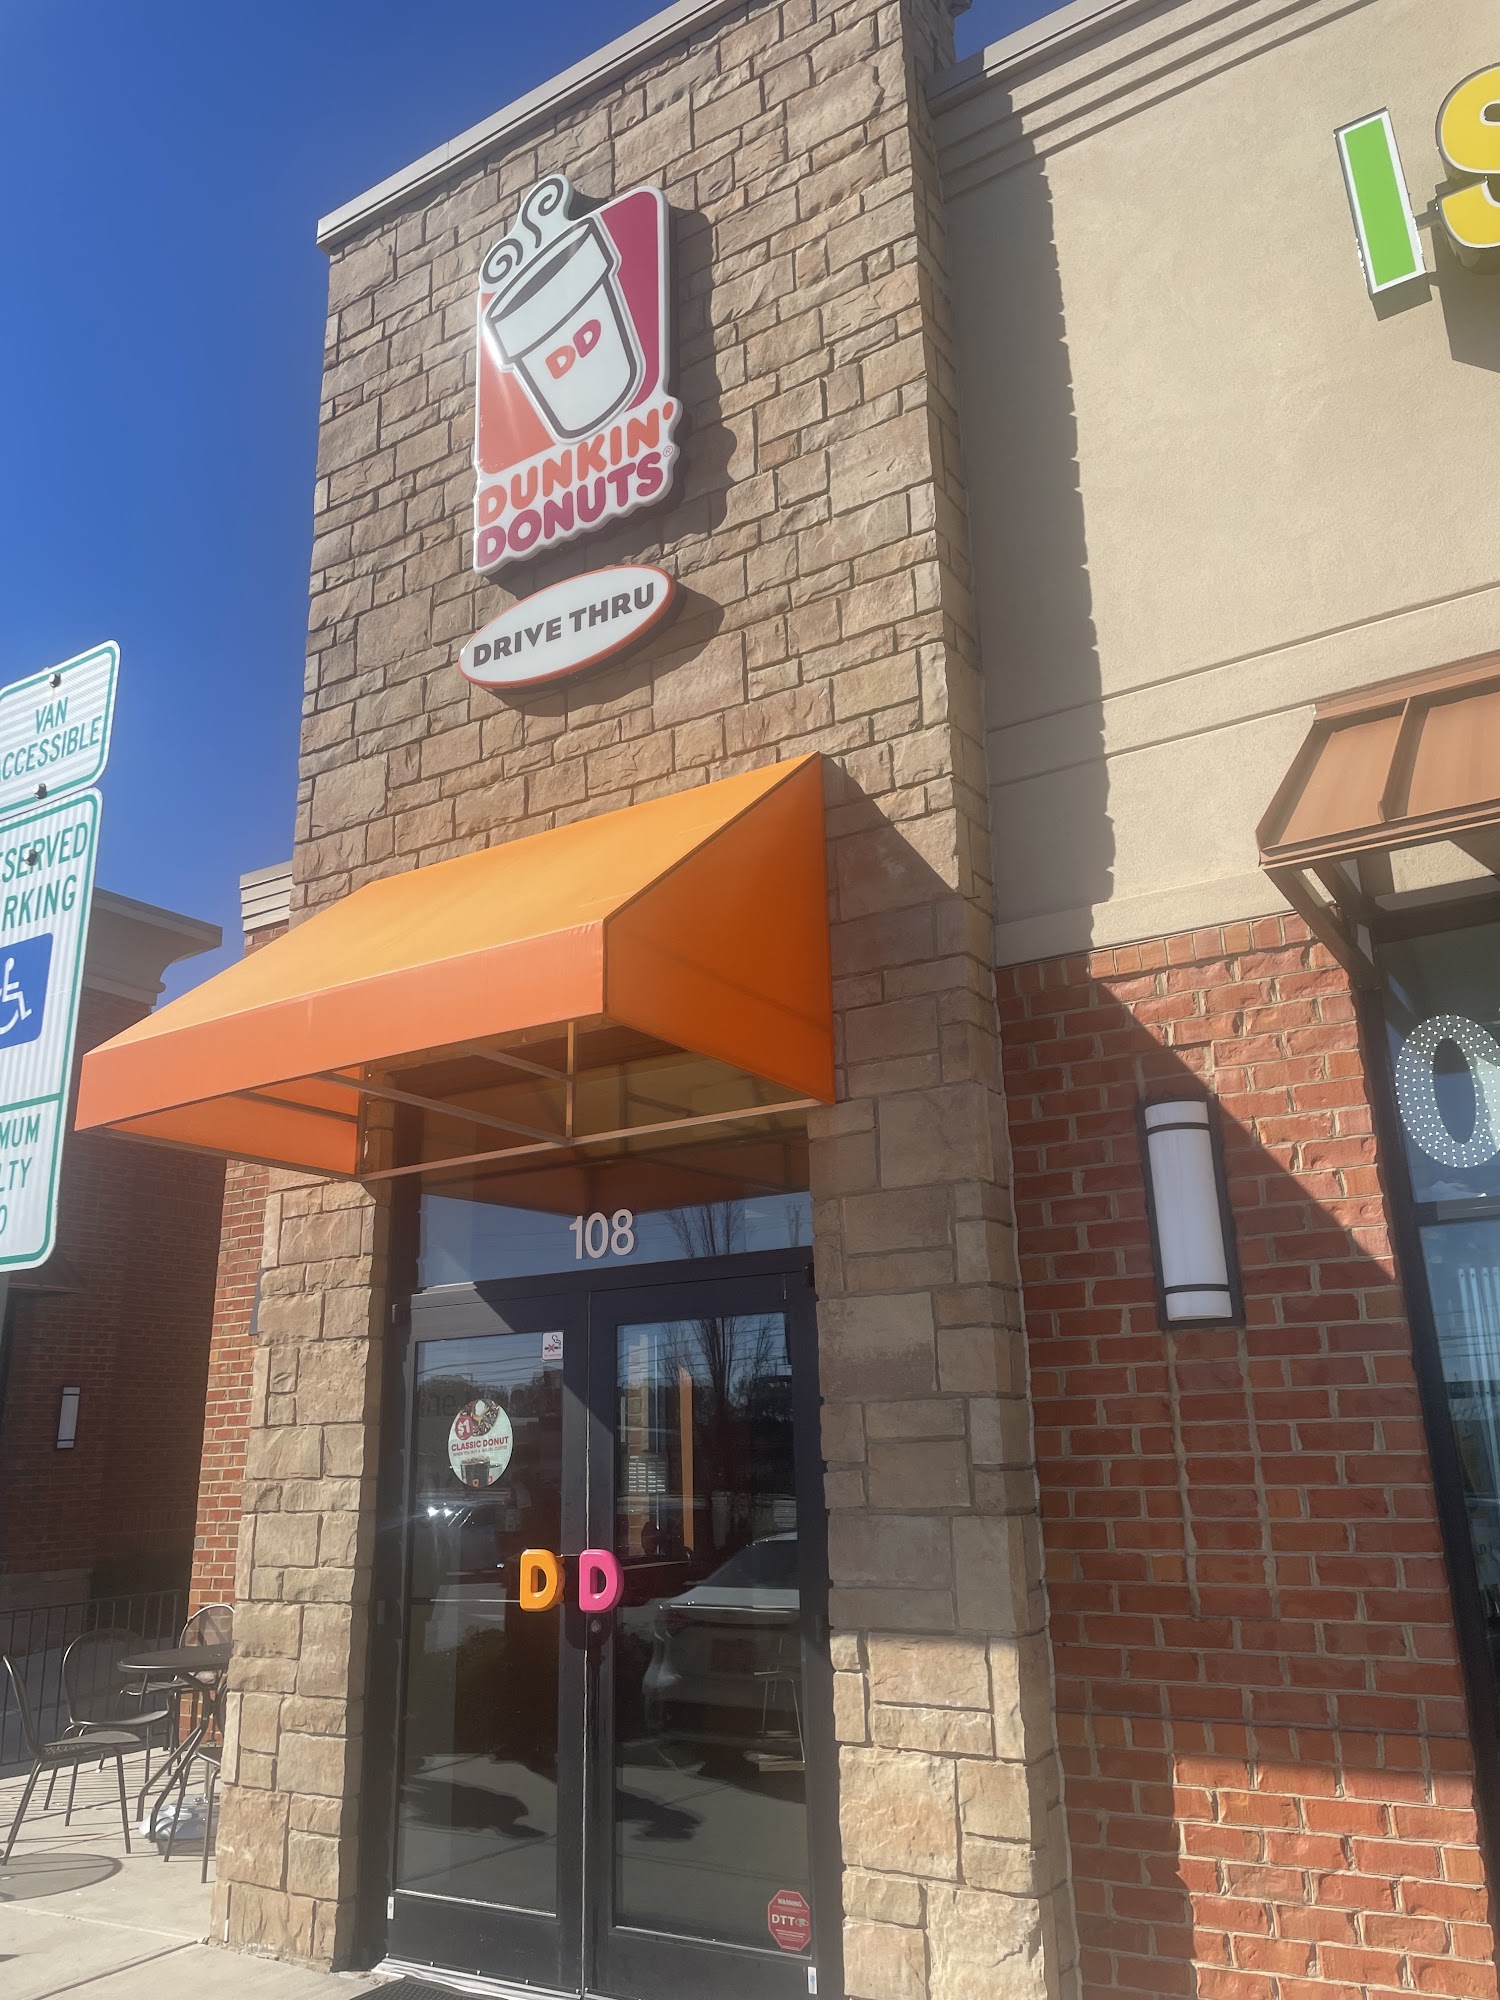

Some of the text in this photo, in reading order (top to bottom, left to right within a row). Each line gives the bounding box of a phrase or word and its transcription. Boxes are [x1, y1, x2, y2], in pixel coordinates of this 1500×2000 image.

[544, 318, 602, 380] DD
[478, 401, 674, 528] DUNKIN'
[477, 451, 664, 568] DONUTS
[473, 582, 655, 668] DRIVE THRU
[35, 696, 69, 735] VAN
[0, 715, 103, 780] CCESSIBLE
[0, 821, 88, 883] SERVED
[569, 1208, 635, 1260] 108
[452, 1436, 509, 1451] CLASSIC DONUT
[458, 1419, 471, 1436] $1
[519, 1548, 625, 1614] D D
